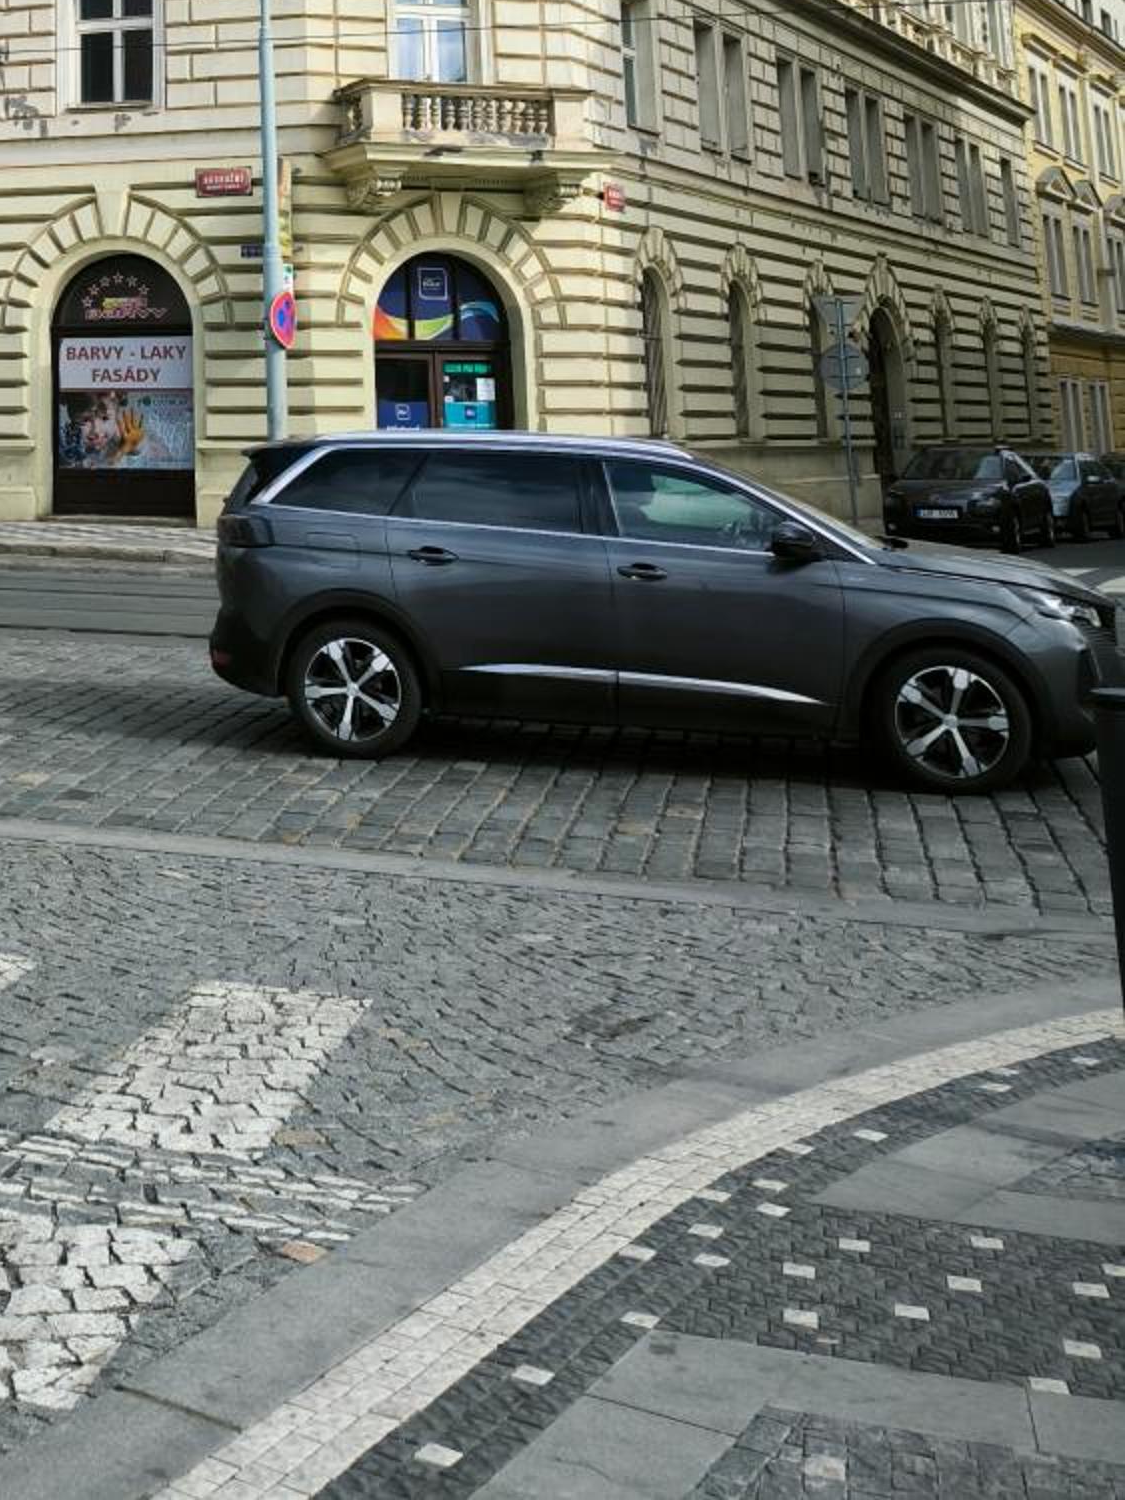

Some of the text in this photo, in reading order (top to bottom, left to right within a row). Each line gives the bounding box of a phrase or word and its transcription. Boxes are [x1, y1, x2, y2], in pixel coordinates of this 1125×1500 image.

[66, 345, 124, 361] BARVY
[139, 344, 187, 360] LAKY
[91, 364, 161, 383] FASÁDY
